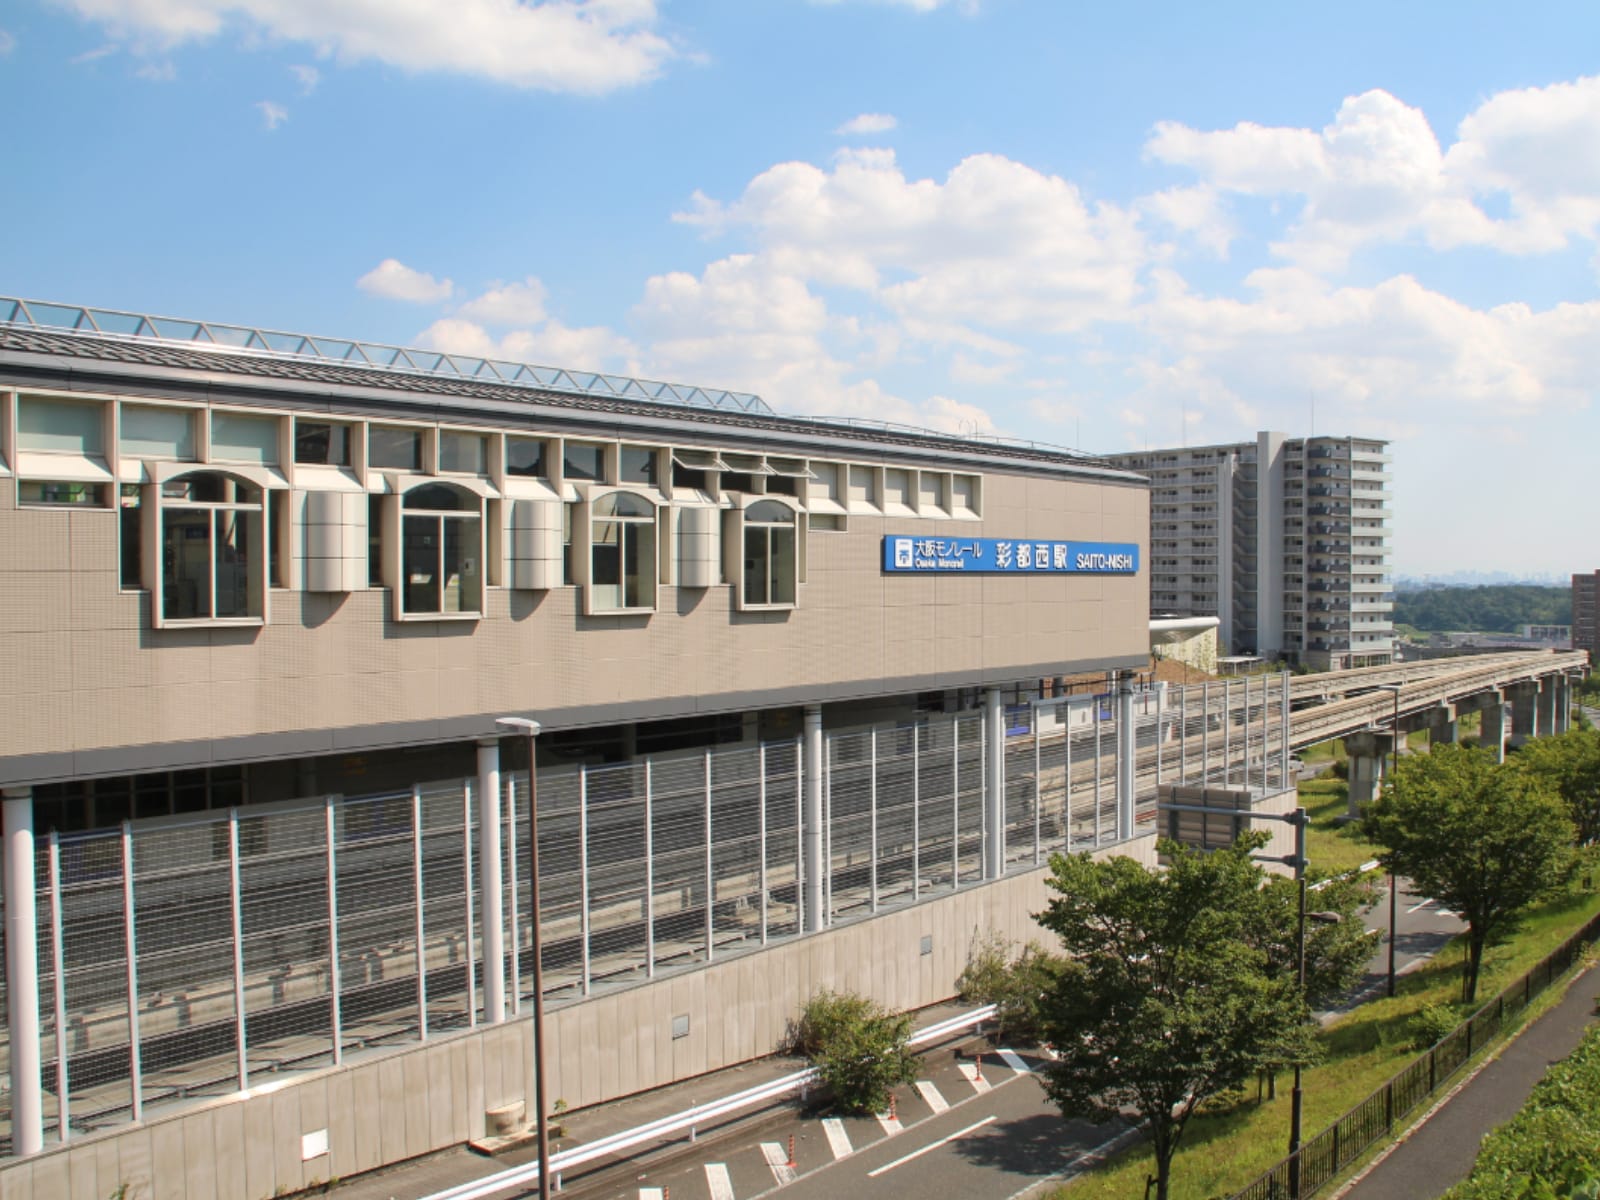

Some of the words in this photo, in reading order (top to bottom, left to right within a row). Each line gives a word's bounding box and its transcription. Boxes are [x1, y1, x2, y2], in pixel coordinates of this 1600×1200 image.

[915, 540, 982, 558] 大阪モノレール
[996, 542, 1068, 569] 彩都西駅
[1076, 553, 1133, 569] SAITO-NISHI
